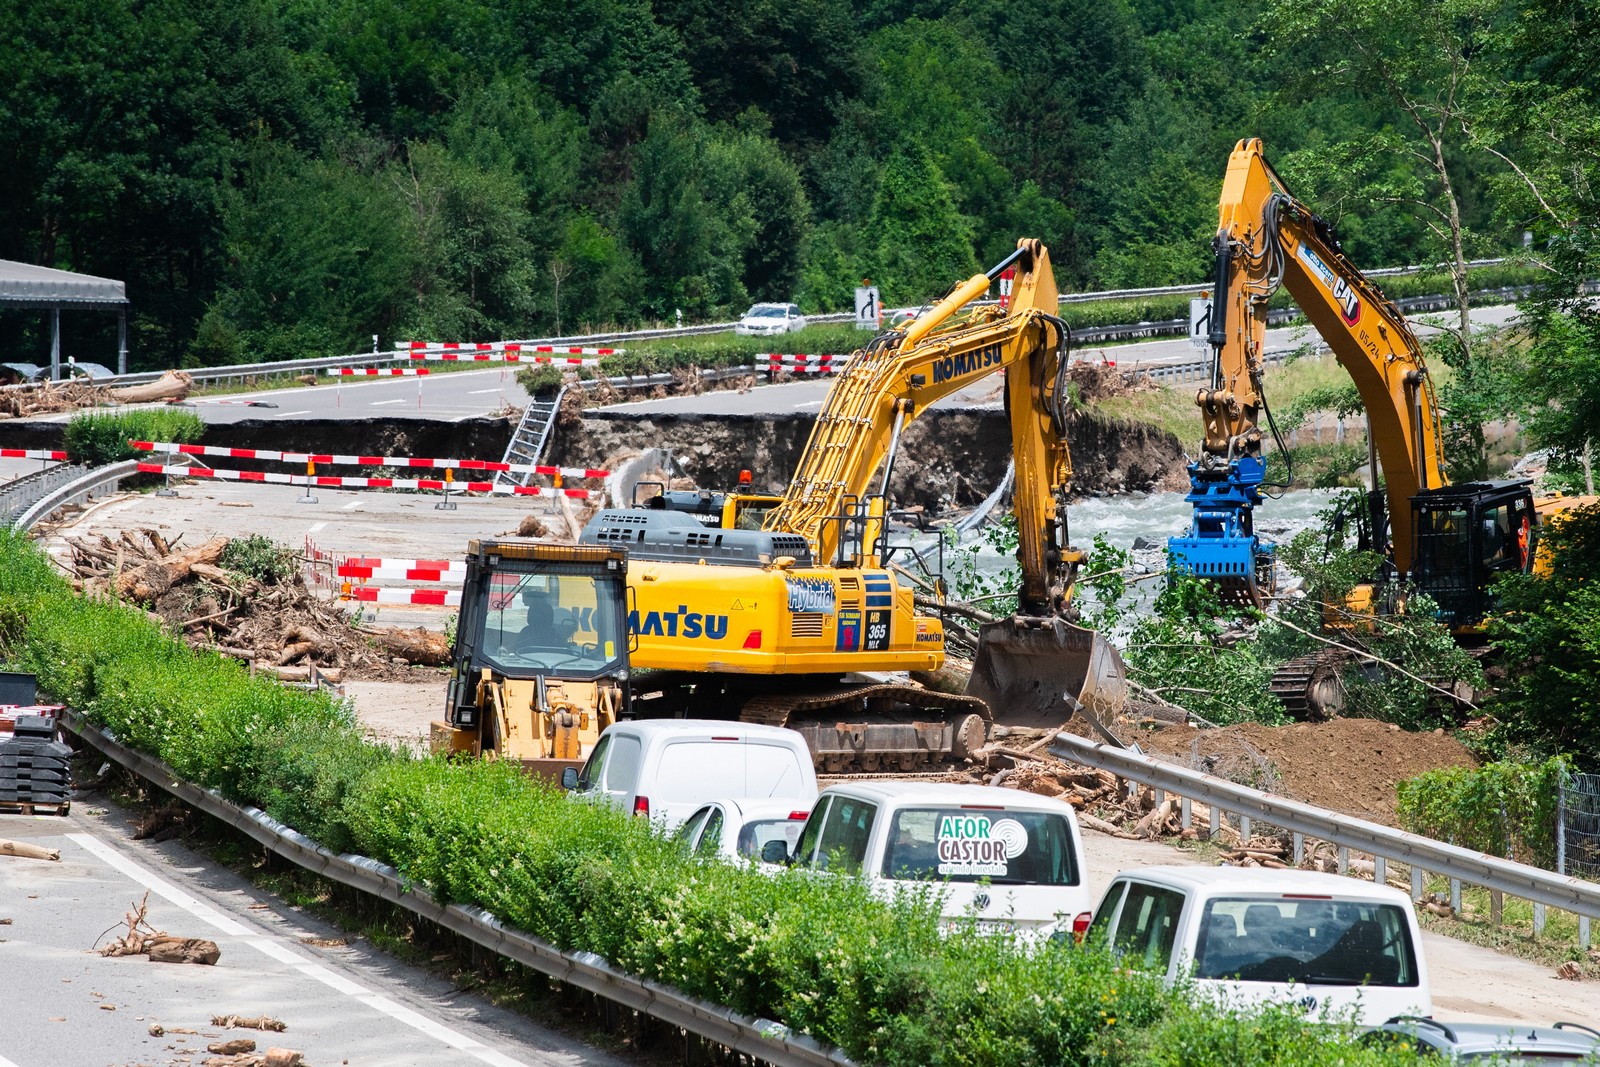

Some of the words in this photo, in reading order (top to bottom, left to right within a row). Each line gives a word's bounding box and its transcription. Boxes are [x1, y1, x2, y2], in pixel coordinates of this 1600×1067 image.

[1333, 276, 1358, 317] CAT
[1359, 329, 1380, 360] 05/24
[932, 339, 1002, 384] KOMATSU
[788, 584, 833, 612] Hybrid
[869, 611, 880, 623] HB
[868, 624, 887, 639] 365
[916, 631, 942, 642] KOMATSU
[941, 818, 990, 839] AFOR
[940, 840, 1005, 861] CASTOR
[939, 863, 970, 874] azienda
[971, 863, 1006, 875] forestale
